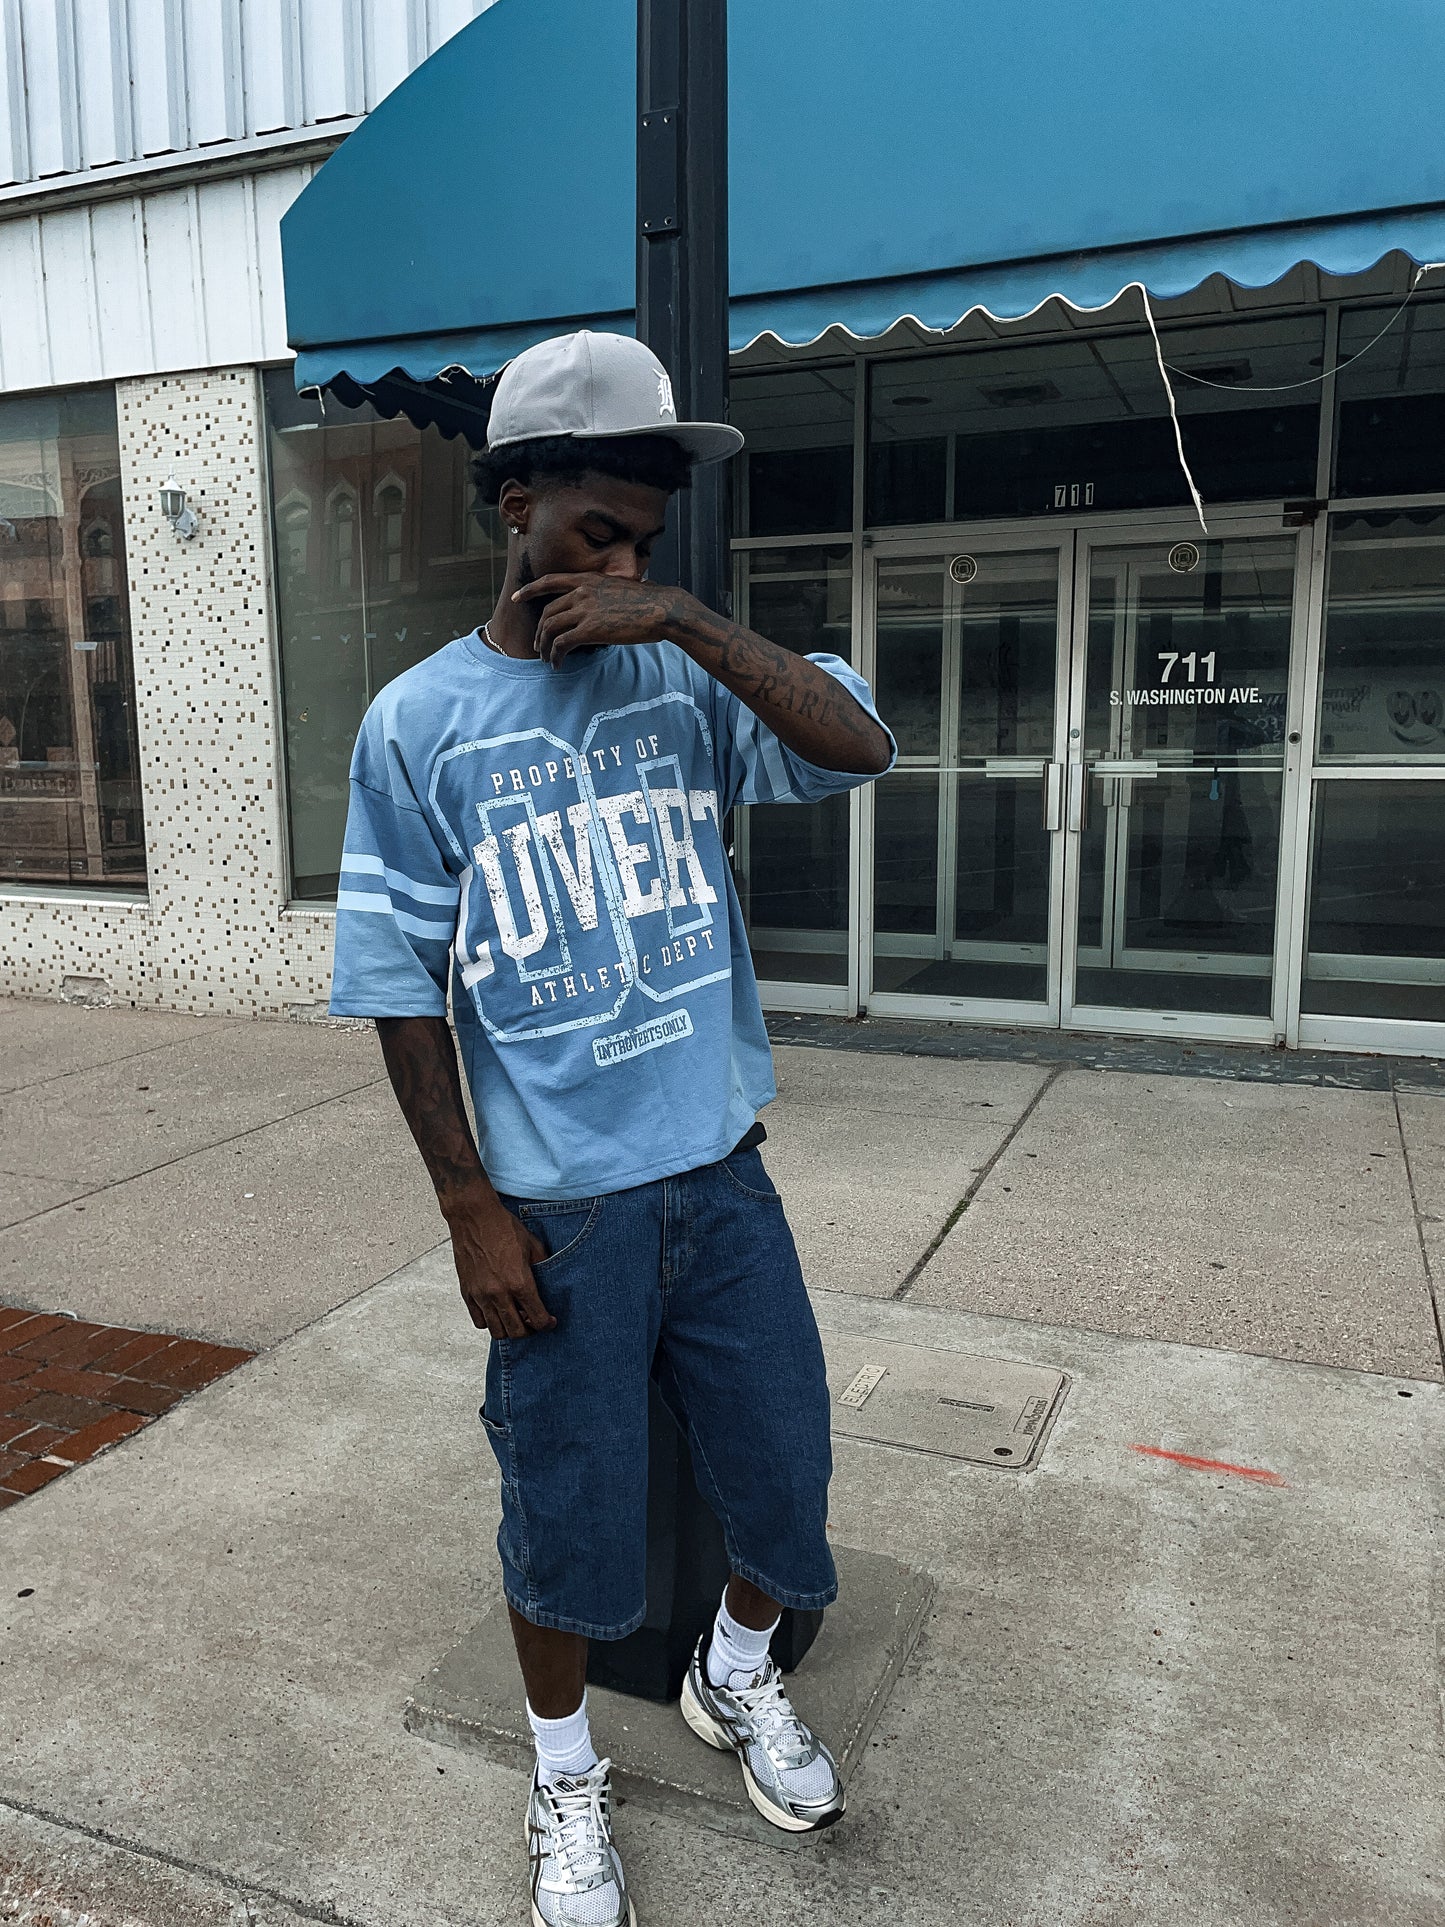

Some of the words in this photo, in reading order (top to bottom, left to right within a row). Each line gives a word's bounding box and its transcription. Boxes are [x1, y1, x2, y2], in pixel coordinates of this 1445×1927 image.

[1055, 484, 1094, 507] 711
[1158, 651, 1216, 683] 711
[1109, 690, 1123, 706] S.
[1126, 687, 1226, 705] WASHINGTON
[1228, 687, 1263, 704] AVE.
[490, 745, 623, 795] PROPERTY
[635, 734, 659, 759] OF
[531, 953, 652, 1007] ATHLETIC
[660, 928, 715, 968] DEPT
[596, 1014, 688, 1062] INTROVERTSONLY
